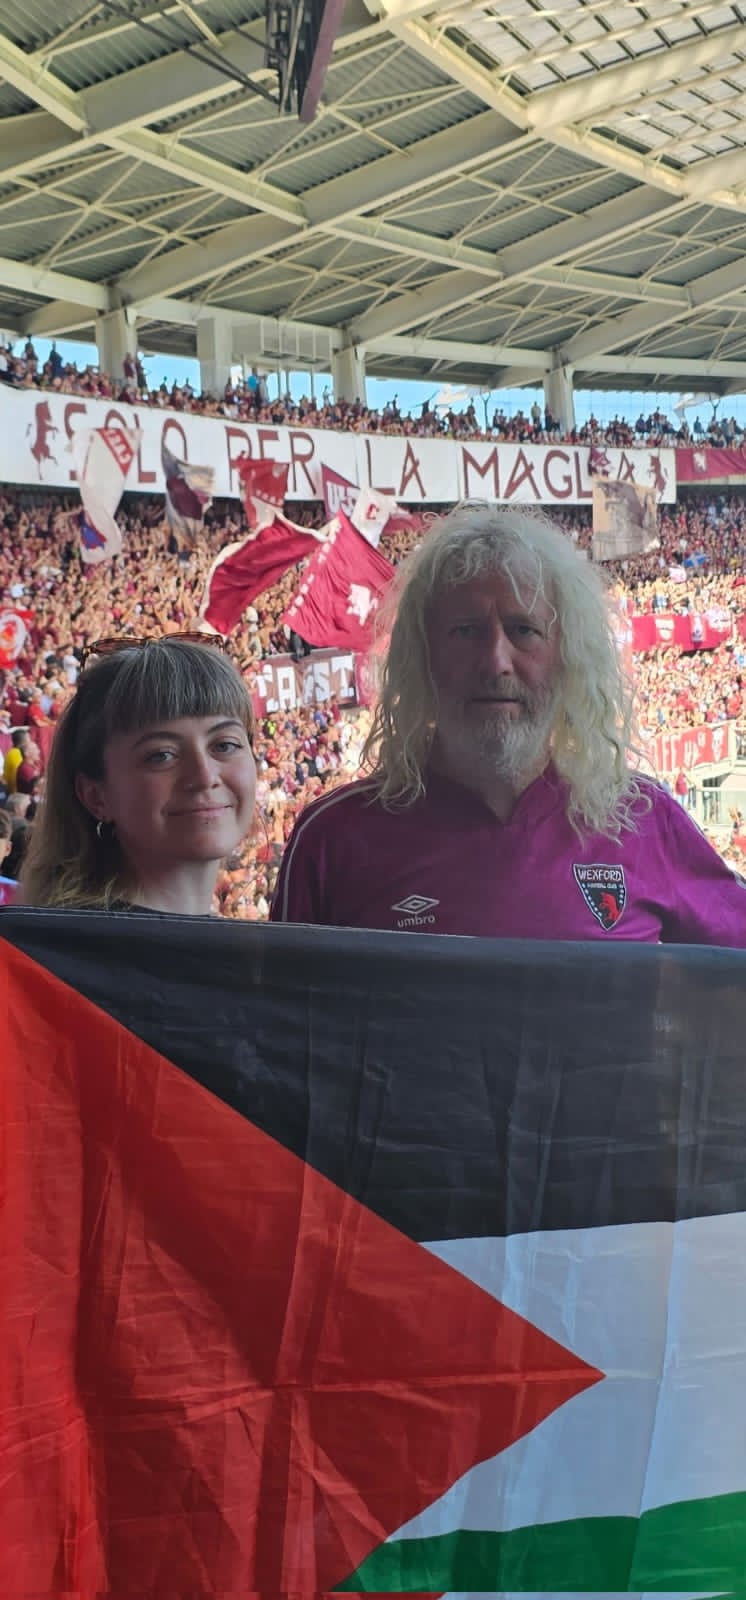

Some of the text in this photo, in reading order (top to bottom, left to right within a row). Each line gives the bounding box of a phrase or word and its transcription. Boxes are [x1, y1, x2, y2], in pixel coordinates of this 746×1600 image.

[365, 439, 427, 498] LA
[461, 447, 636, 499] MAGLA
[577, 868, 622, 881] WEXFORD
[397, 914, 436, 928] umbro
